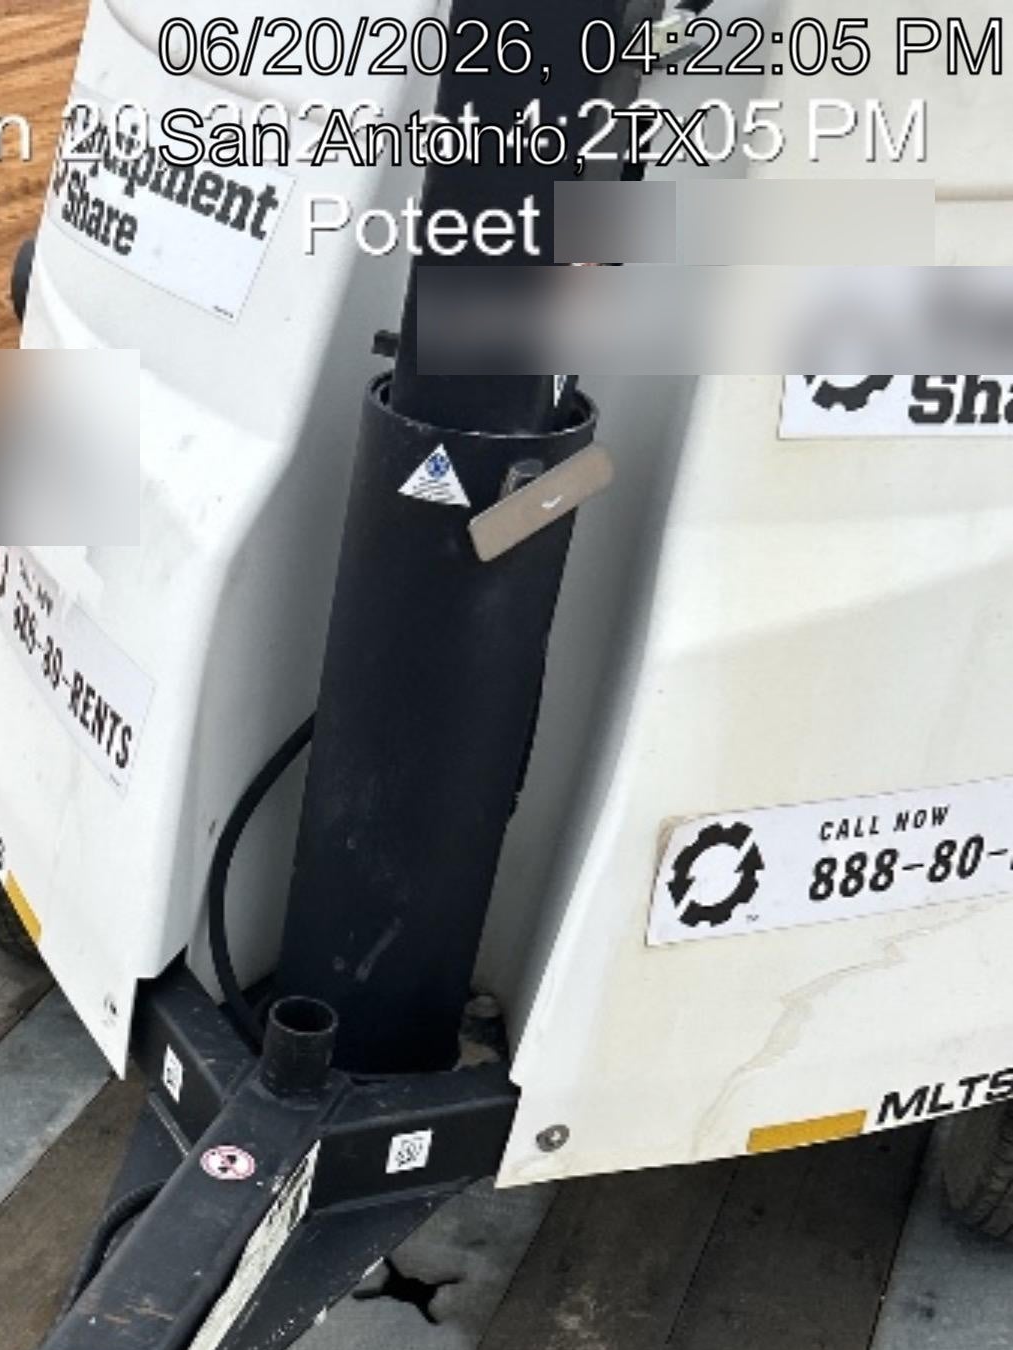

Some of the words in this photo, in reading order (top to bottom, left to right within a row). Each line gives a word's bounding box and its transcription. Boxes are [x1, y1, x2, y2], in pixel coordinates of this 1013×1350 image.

[61, 168, 138, 256] Share
[907, 374, 1013, 425] Sh
[819, 816, 881, 842] CALL
[893, 805, 950, 832] NOW
[808, 833, 1013, 902] 888-80-
